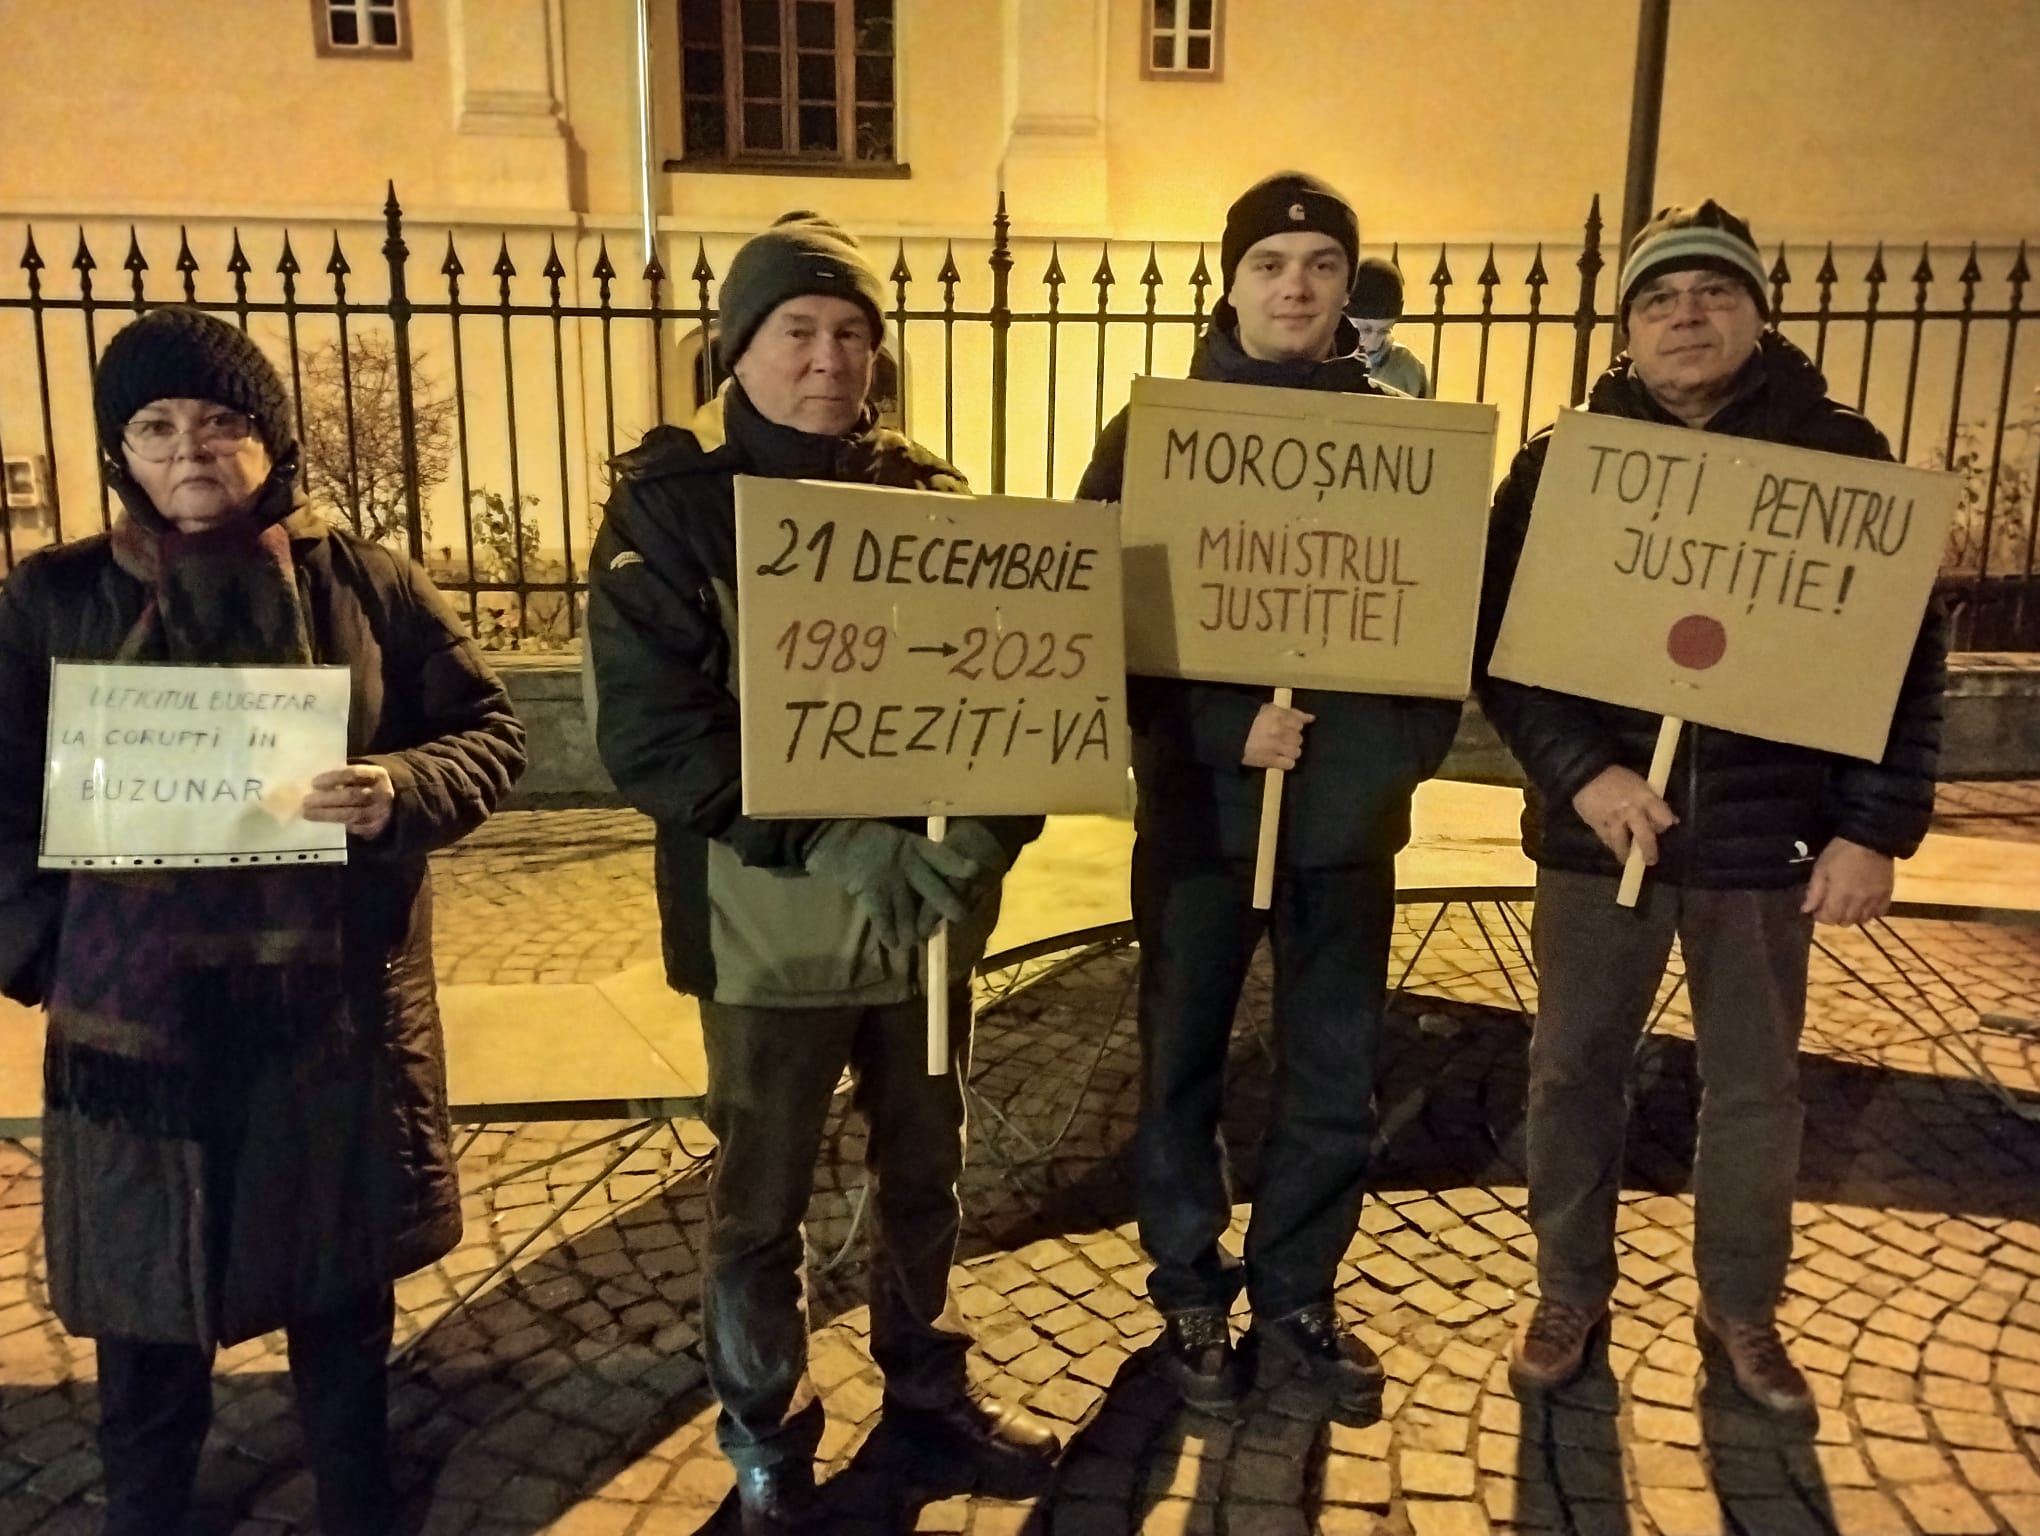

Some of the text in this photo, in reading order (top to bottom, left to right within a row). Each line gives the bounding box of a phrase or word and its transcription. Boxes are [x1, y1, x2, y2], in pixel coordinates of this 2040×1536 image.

[1164, 427, 1434, 502] MOROȘANU
[1749, 473, 1914, 556] PENTRU
[756, 518, 1098, 592] 21 DECEMBRIE
[1198, 520, 1419, 586] MINISTRUL
[776, 619, 1094, 681] 1989 2025
[62, 730, 85, 746] LA
[82, 778, 263, 801] BUZUNAR
